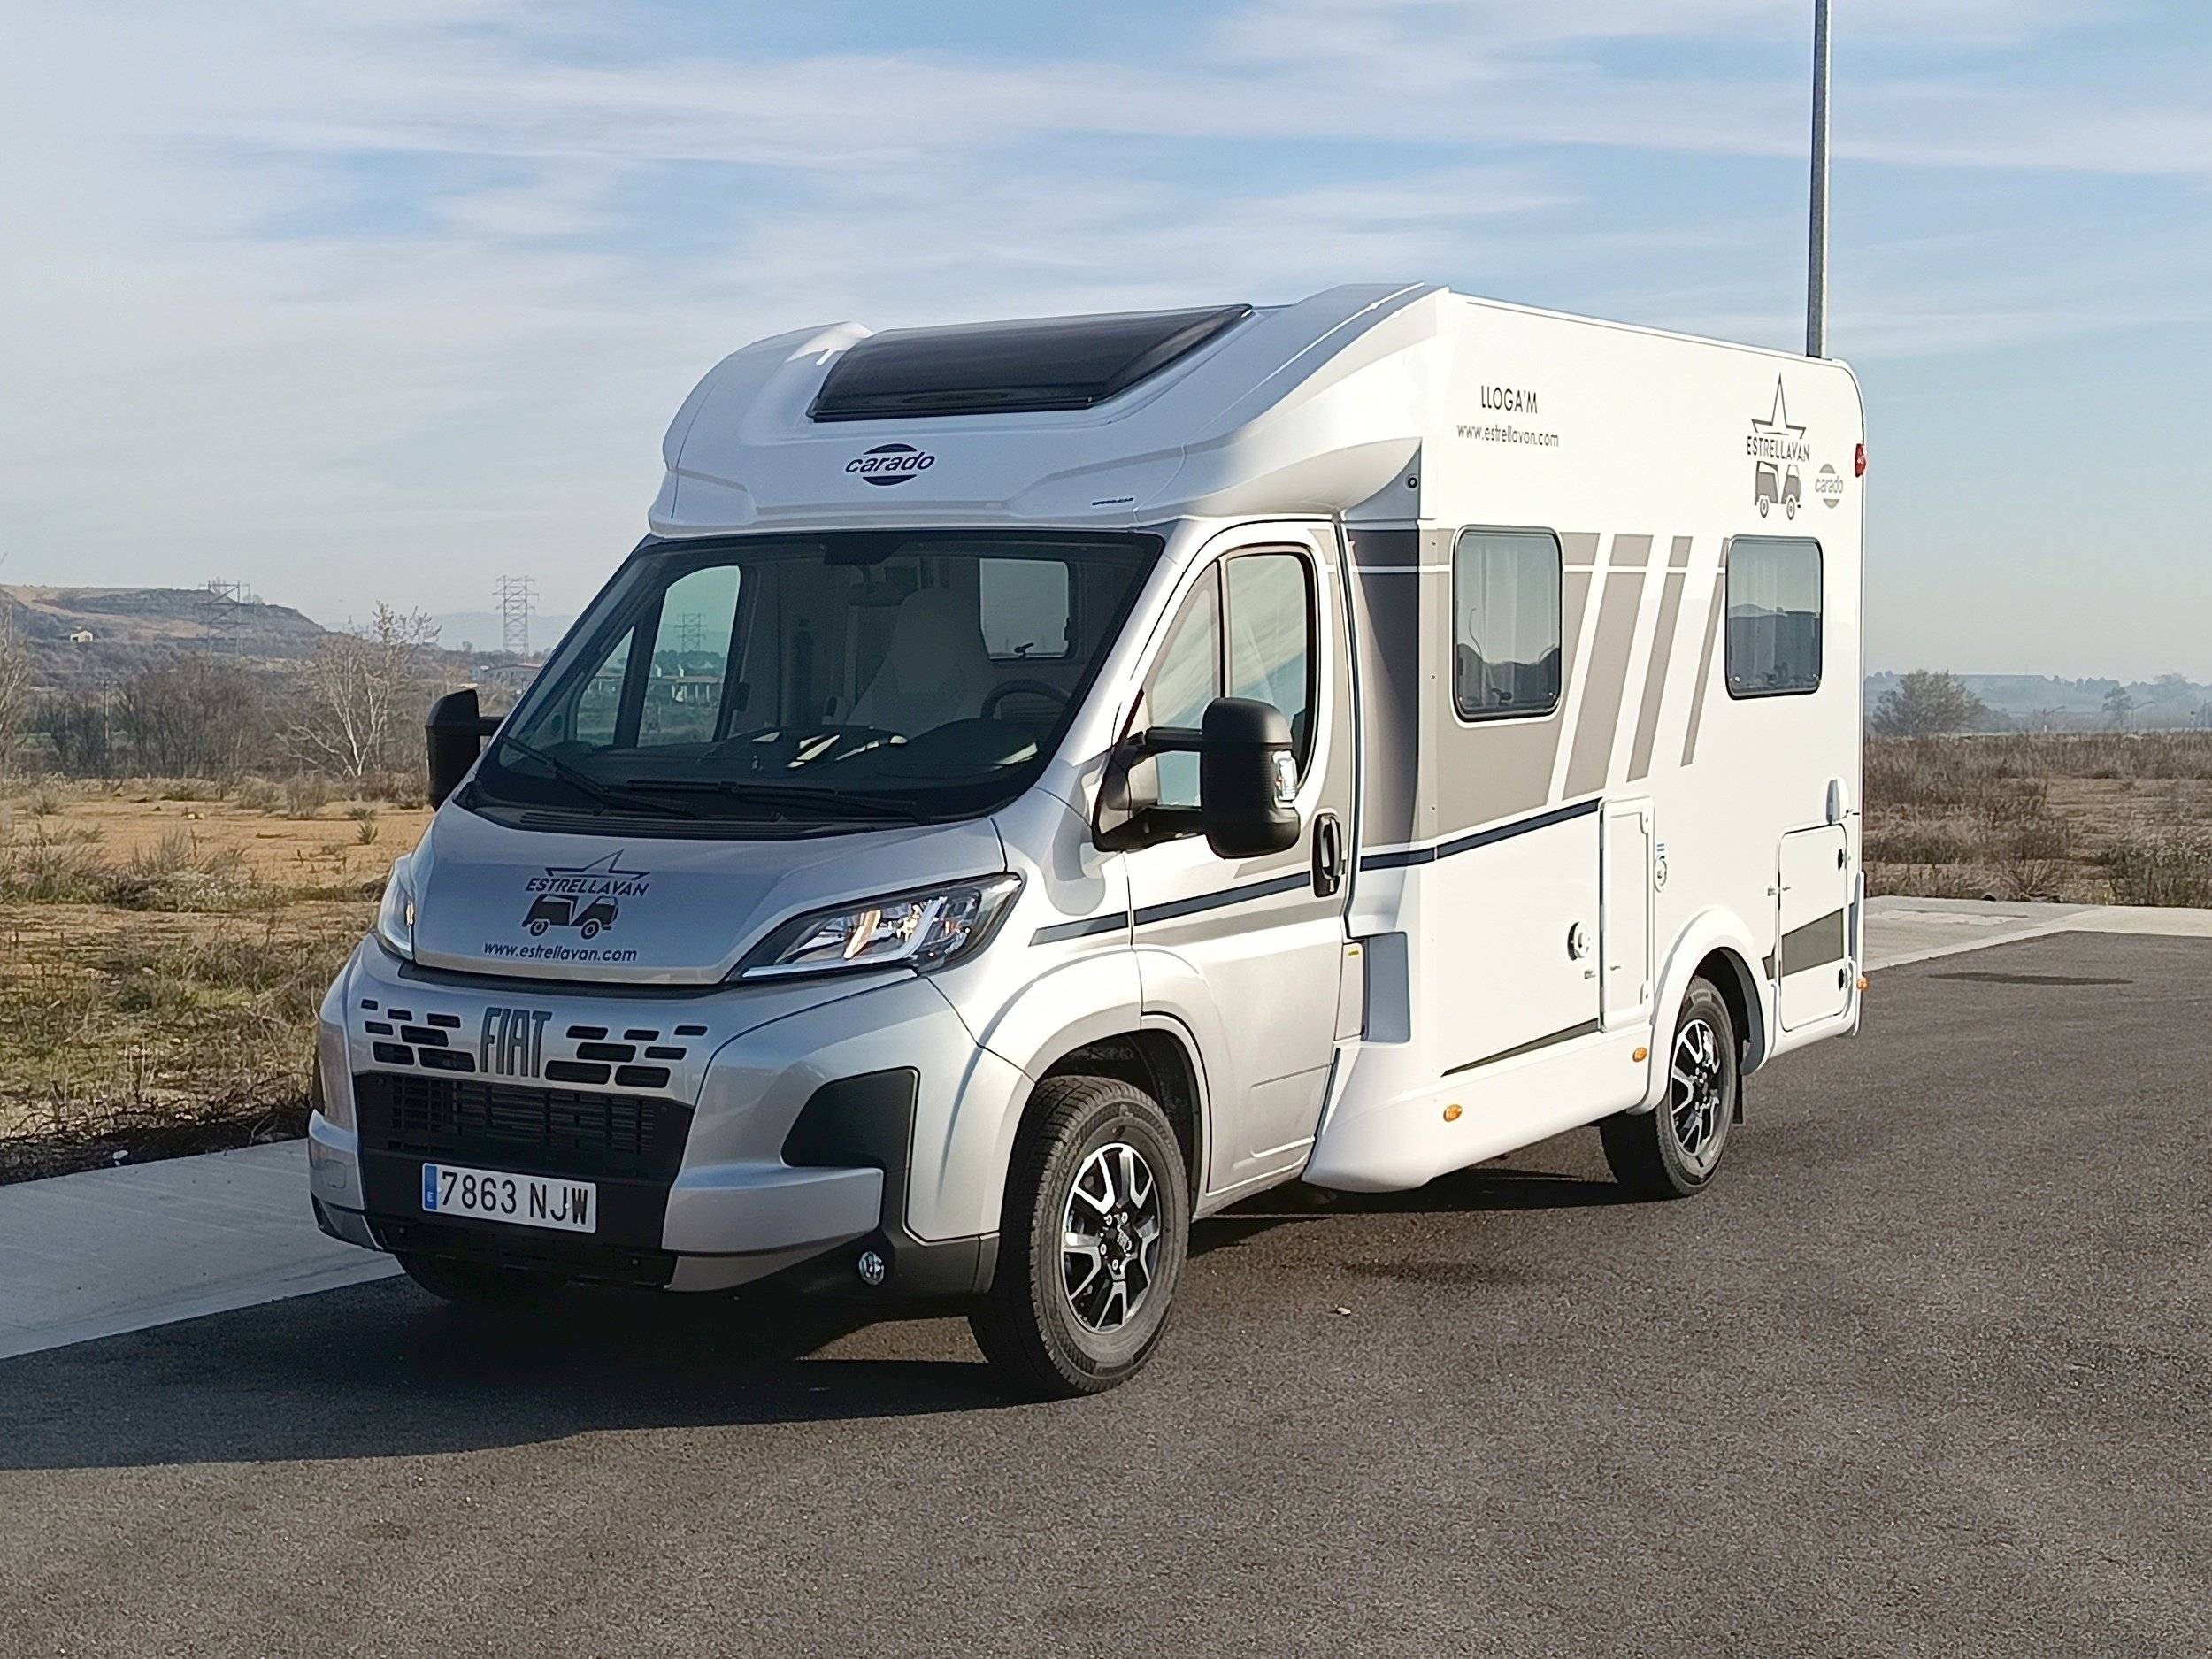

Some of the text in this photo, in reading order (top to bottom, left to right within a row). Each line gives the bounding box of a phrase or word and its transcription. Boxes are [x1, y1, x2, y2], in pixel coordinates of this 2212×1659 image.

[1480, 385, 1538, 414] LLOGA'M
[1456, 424, 1559, 447] www.estrellavan.com
[1747, 435, 1810, 462] ESTRELLAVAN
[846, 451, 935, 473] carado
[1815, 475, 1844, 494] carado
[525, 877, 649, 897] ESTRELLAVAN
[484, 941, 637, 962] www.estrellavan.com
[479, 1007, 553, 1079] FIAT
[442, 1171, 588, 1225] 7863 NJW
